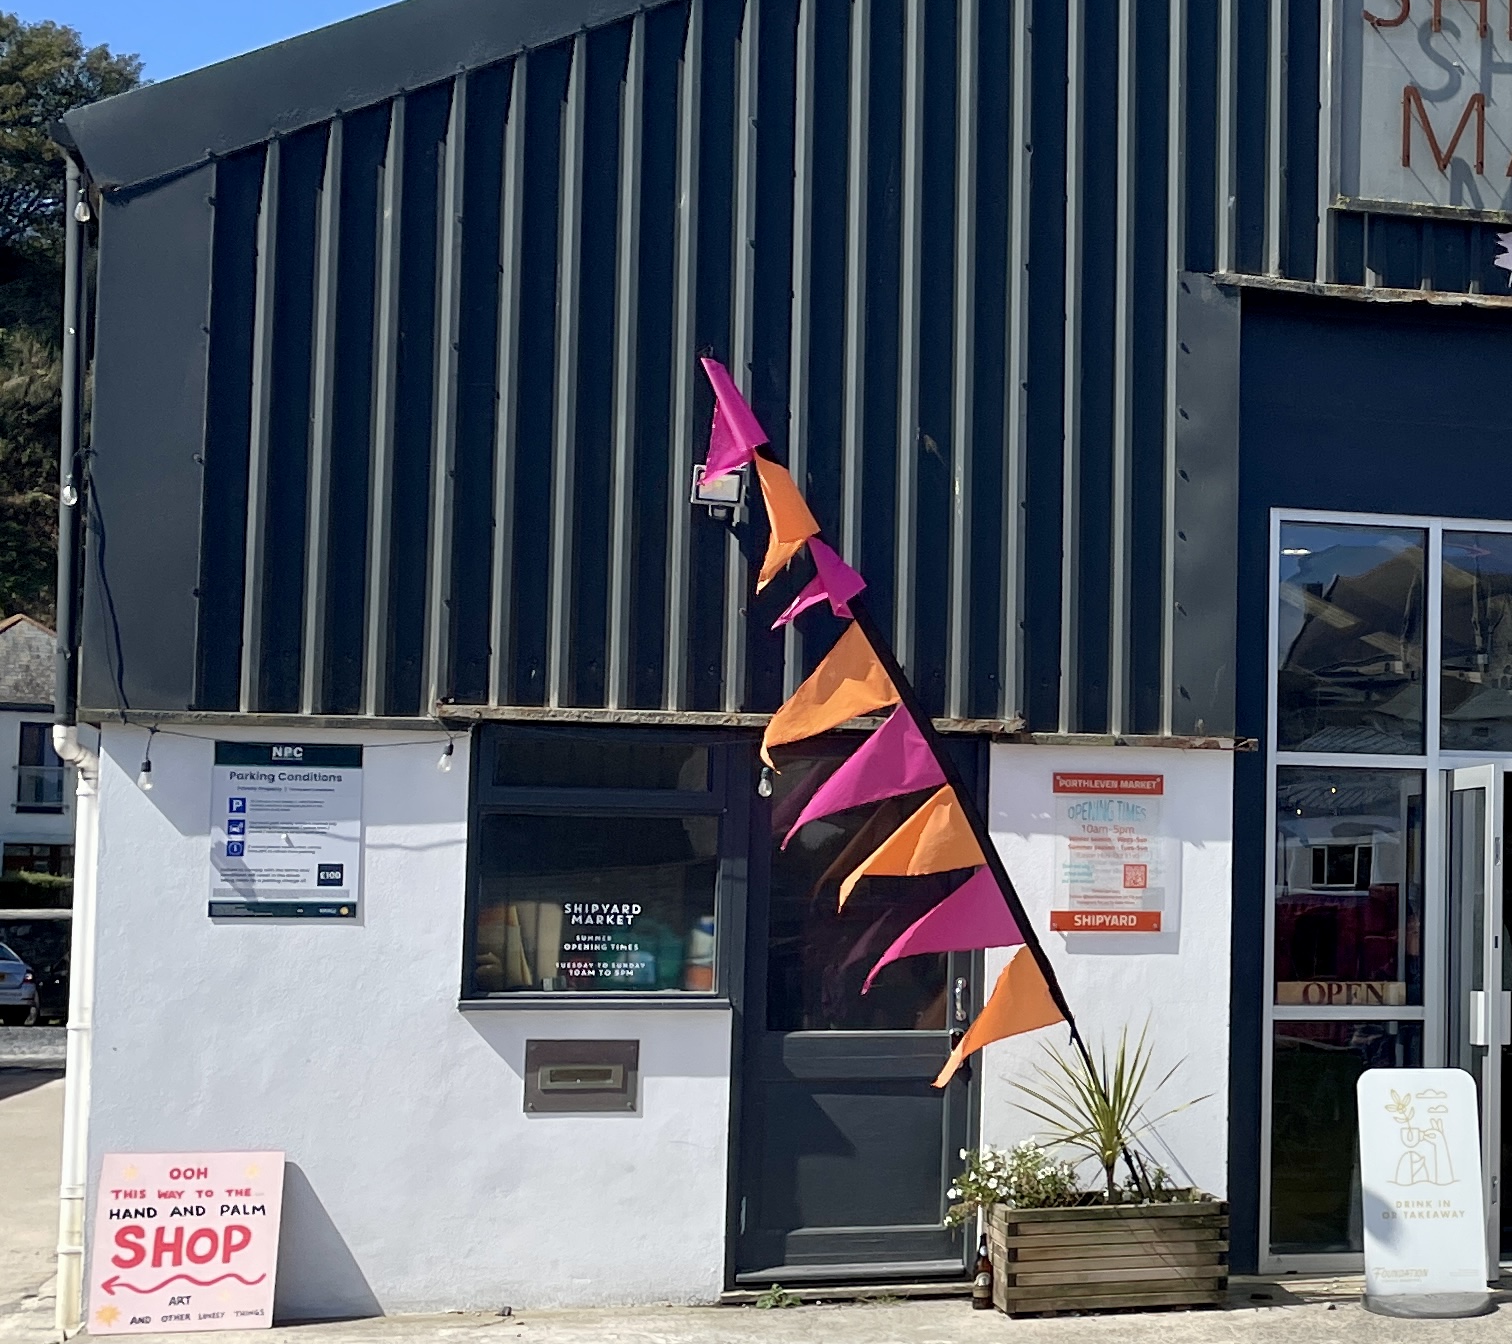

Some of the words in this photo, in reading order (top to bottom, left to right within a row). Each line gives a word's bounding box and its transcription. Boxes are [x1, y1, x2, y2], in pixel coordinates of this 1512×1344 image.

[271, 746, 303, 758] NPC
[229, 771, 275, 784] Parking
[278, 771, 342, 783] Conditions
[1058, 778, 1118, 789] PORTHLEVEN
[1120, 780, 1157, 789] MARKET
[1067, 799, 1115, 822] OPENING
[1116, 800, 1147, 822] TIMES
[319, 870, 341, 880] £100
[563, 903, 642, 915] SHIPYARD
[571, 915, 635, 925] MARKET
[1074, 914, 1137, 927] SHIPYARD
[563, 943, 608, 951] OPENING
[610, 943, 639, 951] TIMES
[568, 969, 596, 977] 10AM
[598, 969, 611, 977] TO
[614, 969, 634, 977] 5PM
[1302, 982, 1386, 1005] OPEN
[169, 1167, 208, 1180] OOH
[110, 1189, 147, 1200] THIS
[157, 1189, 185, 1199] WAY
[195, 1189, 214, 1198] TO
[224, 1188, 252, 1197] THE
[1395, 1200, 1433, 1209] DRINK
[1438, 1199, 1451, 1208] IN
[109, 1206, 158, 1220] HAND
[169, 1205, 206, 1217] AND
[220, 1204, 266, 1216] PALM
[1381, 1211, 1398, 1219] OR
[1403, 1210, 1466, 1219] TAKEAWAY
[111, 1224, 252, 1269] SHOP
[168, 1295, 192, 1306] ART
[129, 1316, 152, 1325] AND
[160, 1313, 191, 1323] OTHER
[233, 1308, 265, 1317] THINGS
